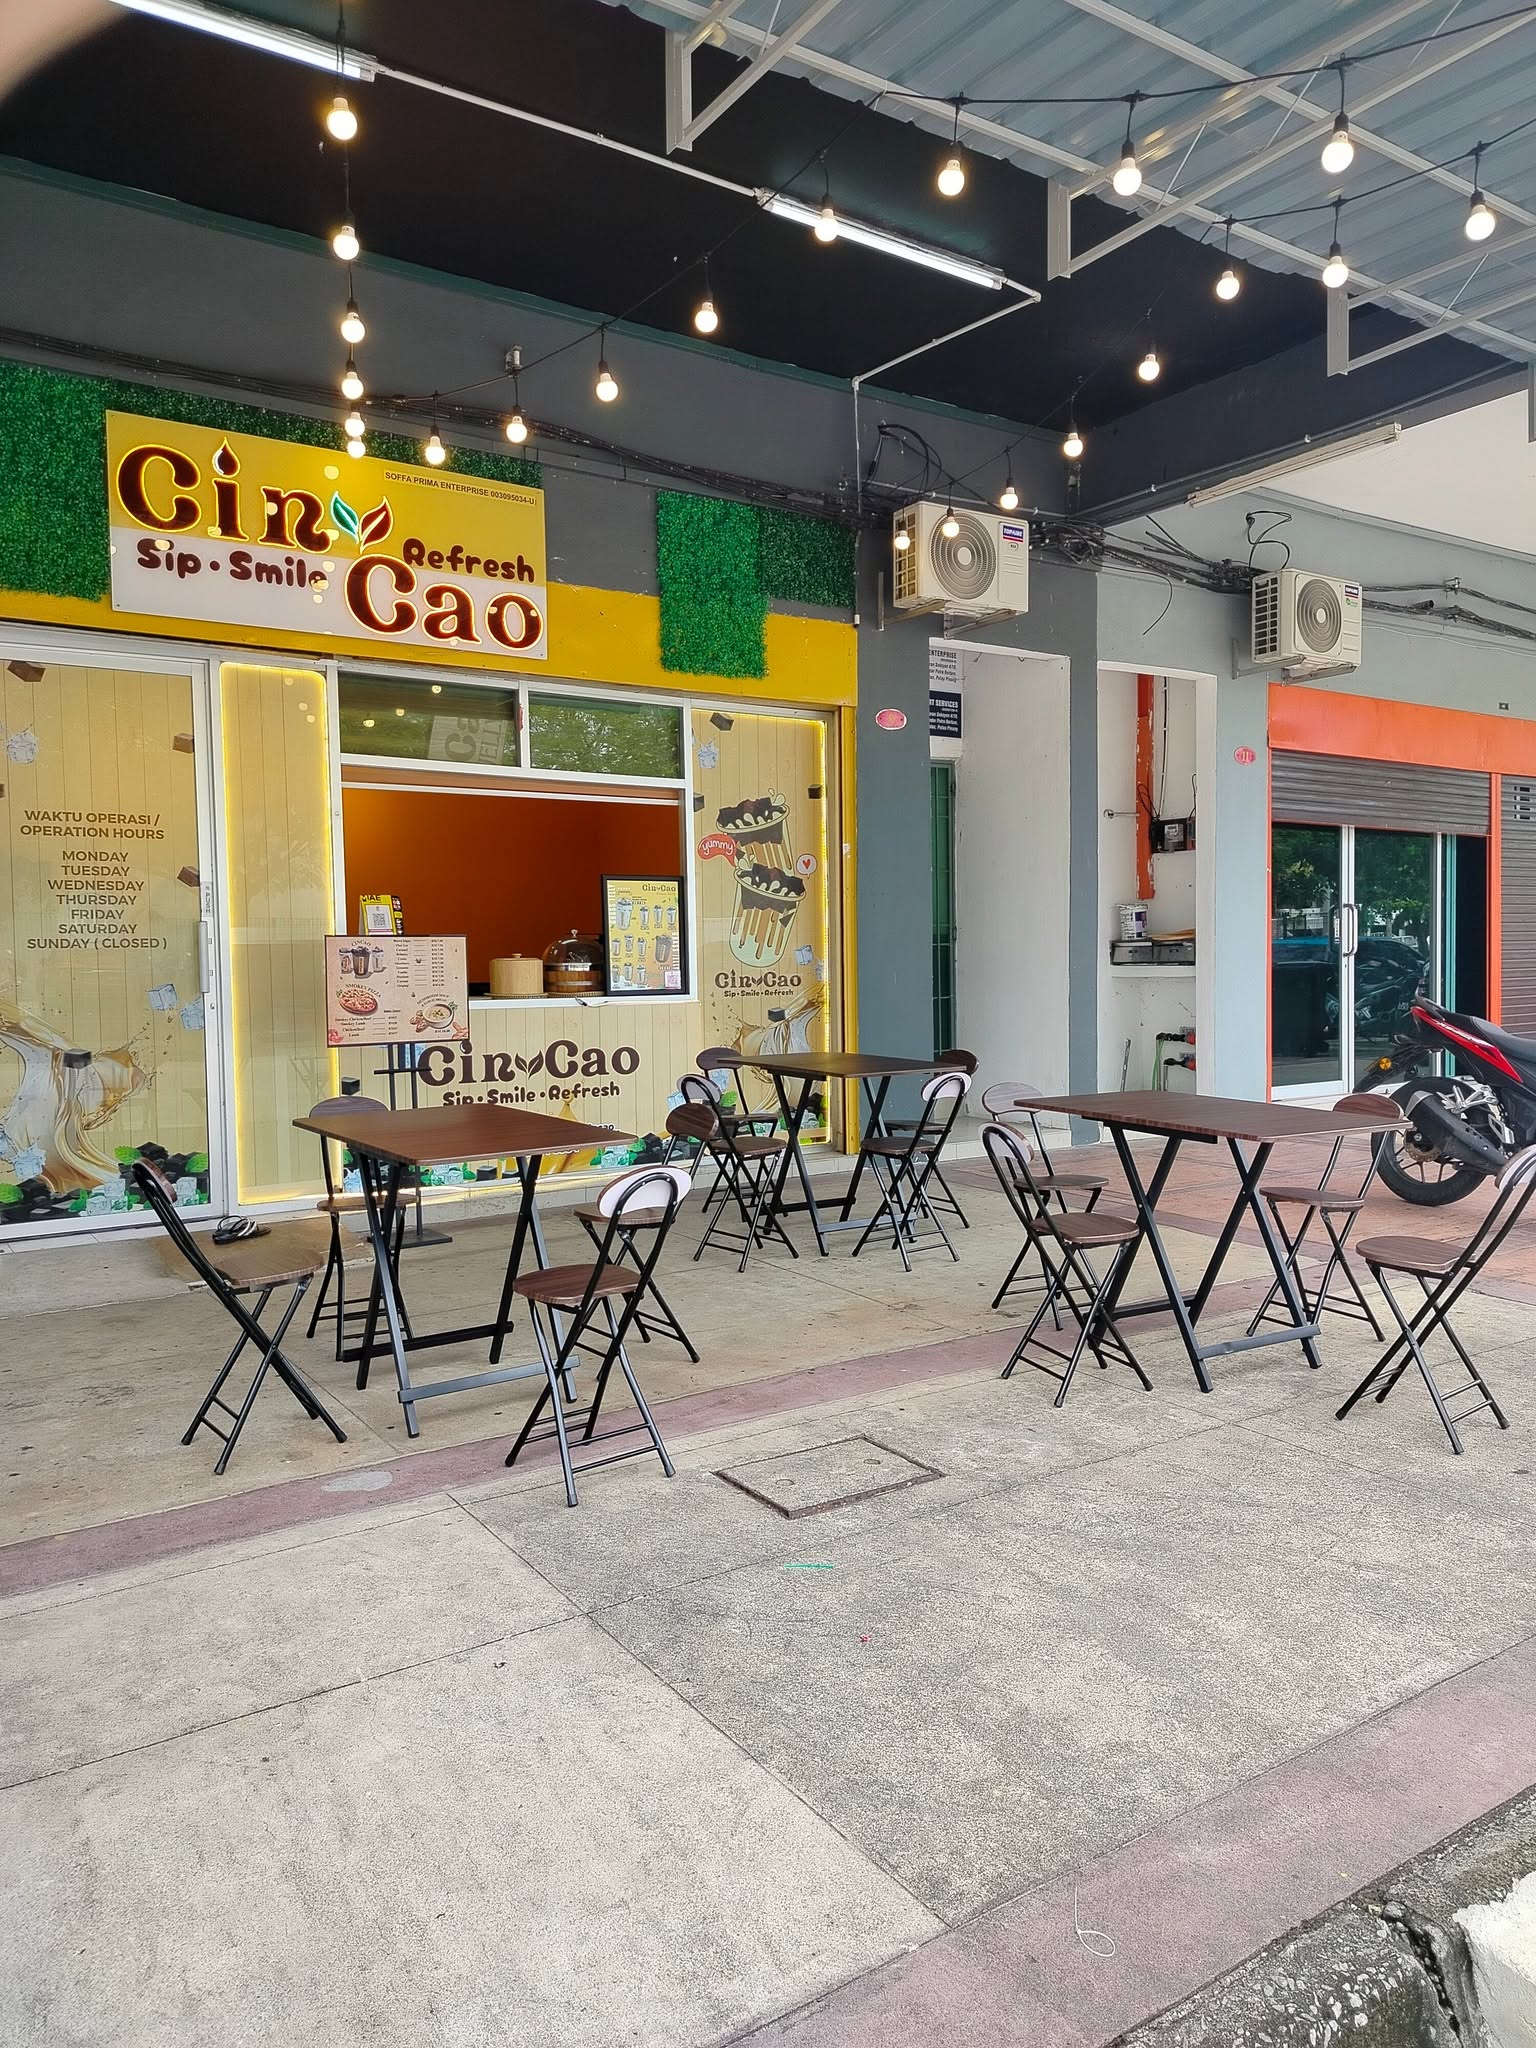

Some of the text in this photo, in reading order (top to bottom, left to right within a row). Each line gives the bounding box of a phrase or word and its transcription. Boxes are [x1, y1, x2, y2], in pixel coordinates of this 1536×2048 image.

[385, 471, 412, 483] SOFFA
[413, 476, 439, 488] PRIMA
[441, 481, 489, 497] ENTERPRISE
[116, 437, 332, 553] Cin
[137, 538, 329, 589] Sip Smile
[403, 538, 536, 583] Refresh
[345, 554, 544, 650] Cao
[24, 810, 82, 822] WAKTU
[86, 812, 151, 825] OPERASI
[20, 825, 165, 840] OPERATION HOURS
[701, 840, 734, 856] yummy
[62, 850, 129, 862] MONDAY
[61, 865, 130, 877] TUESDAY
[48, 879, 145, 891] WEDNESDAY
[56, 894, 137, 905] THURSDAY
[71, 909, 124, 920] FRIDAY
[58, 923, 138, 934] SATURDAY
[27, 938, 90, 949] SUNDAY
[714, 969, 802, 988] Cin Cao
[723, 989, 794, 998] Sip Smile Refresh
[417, 1039, 641, 1087] Cin Cao
[487, 1086, 536, 1105] Smile
[549, 1081, 621, 1101] Refresh
